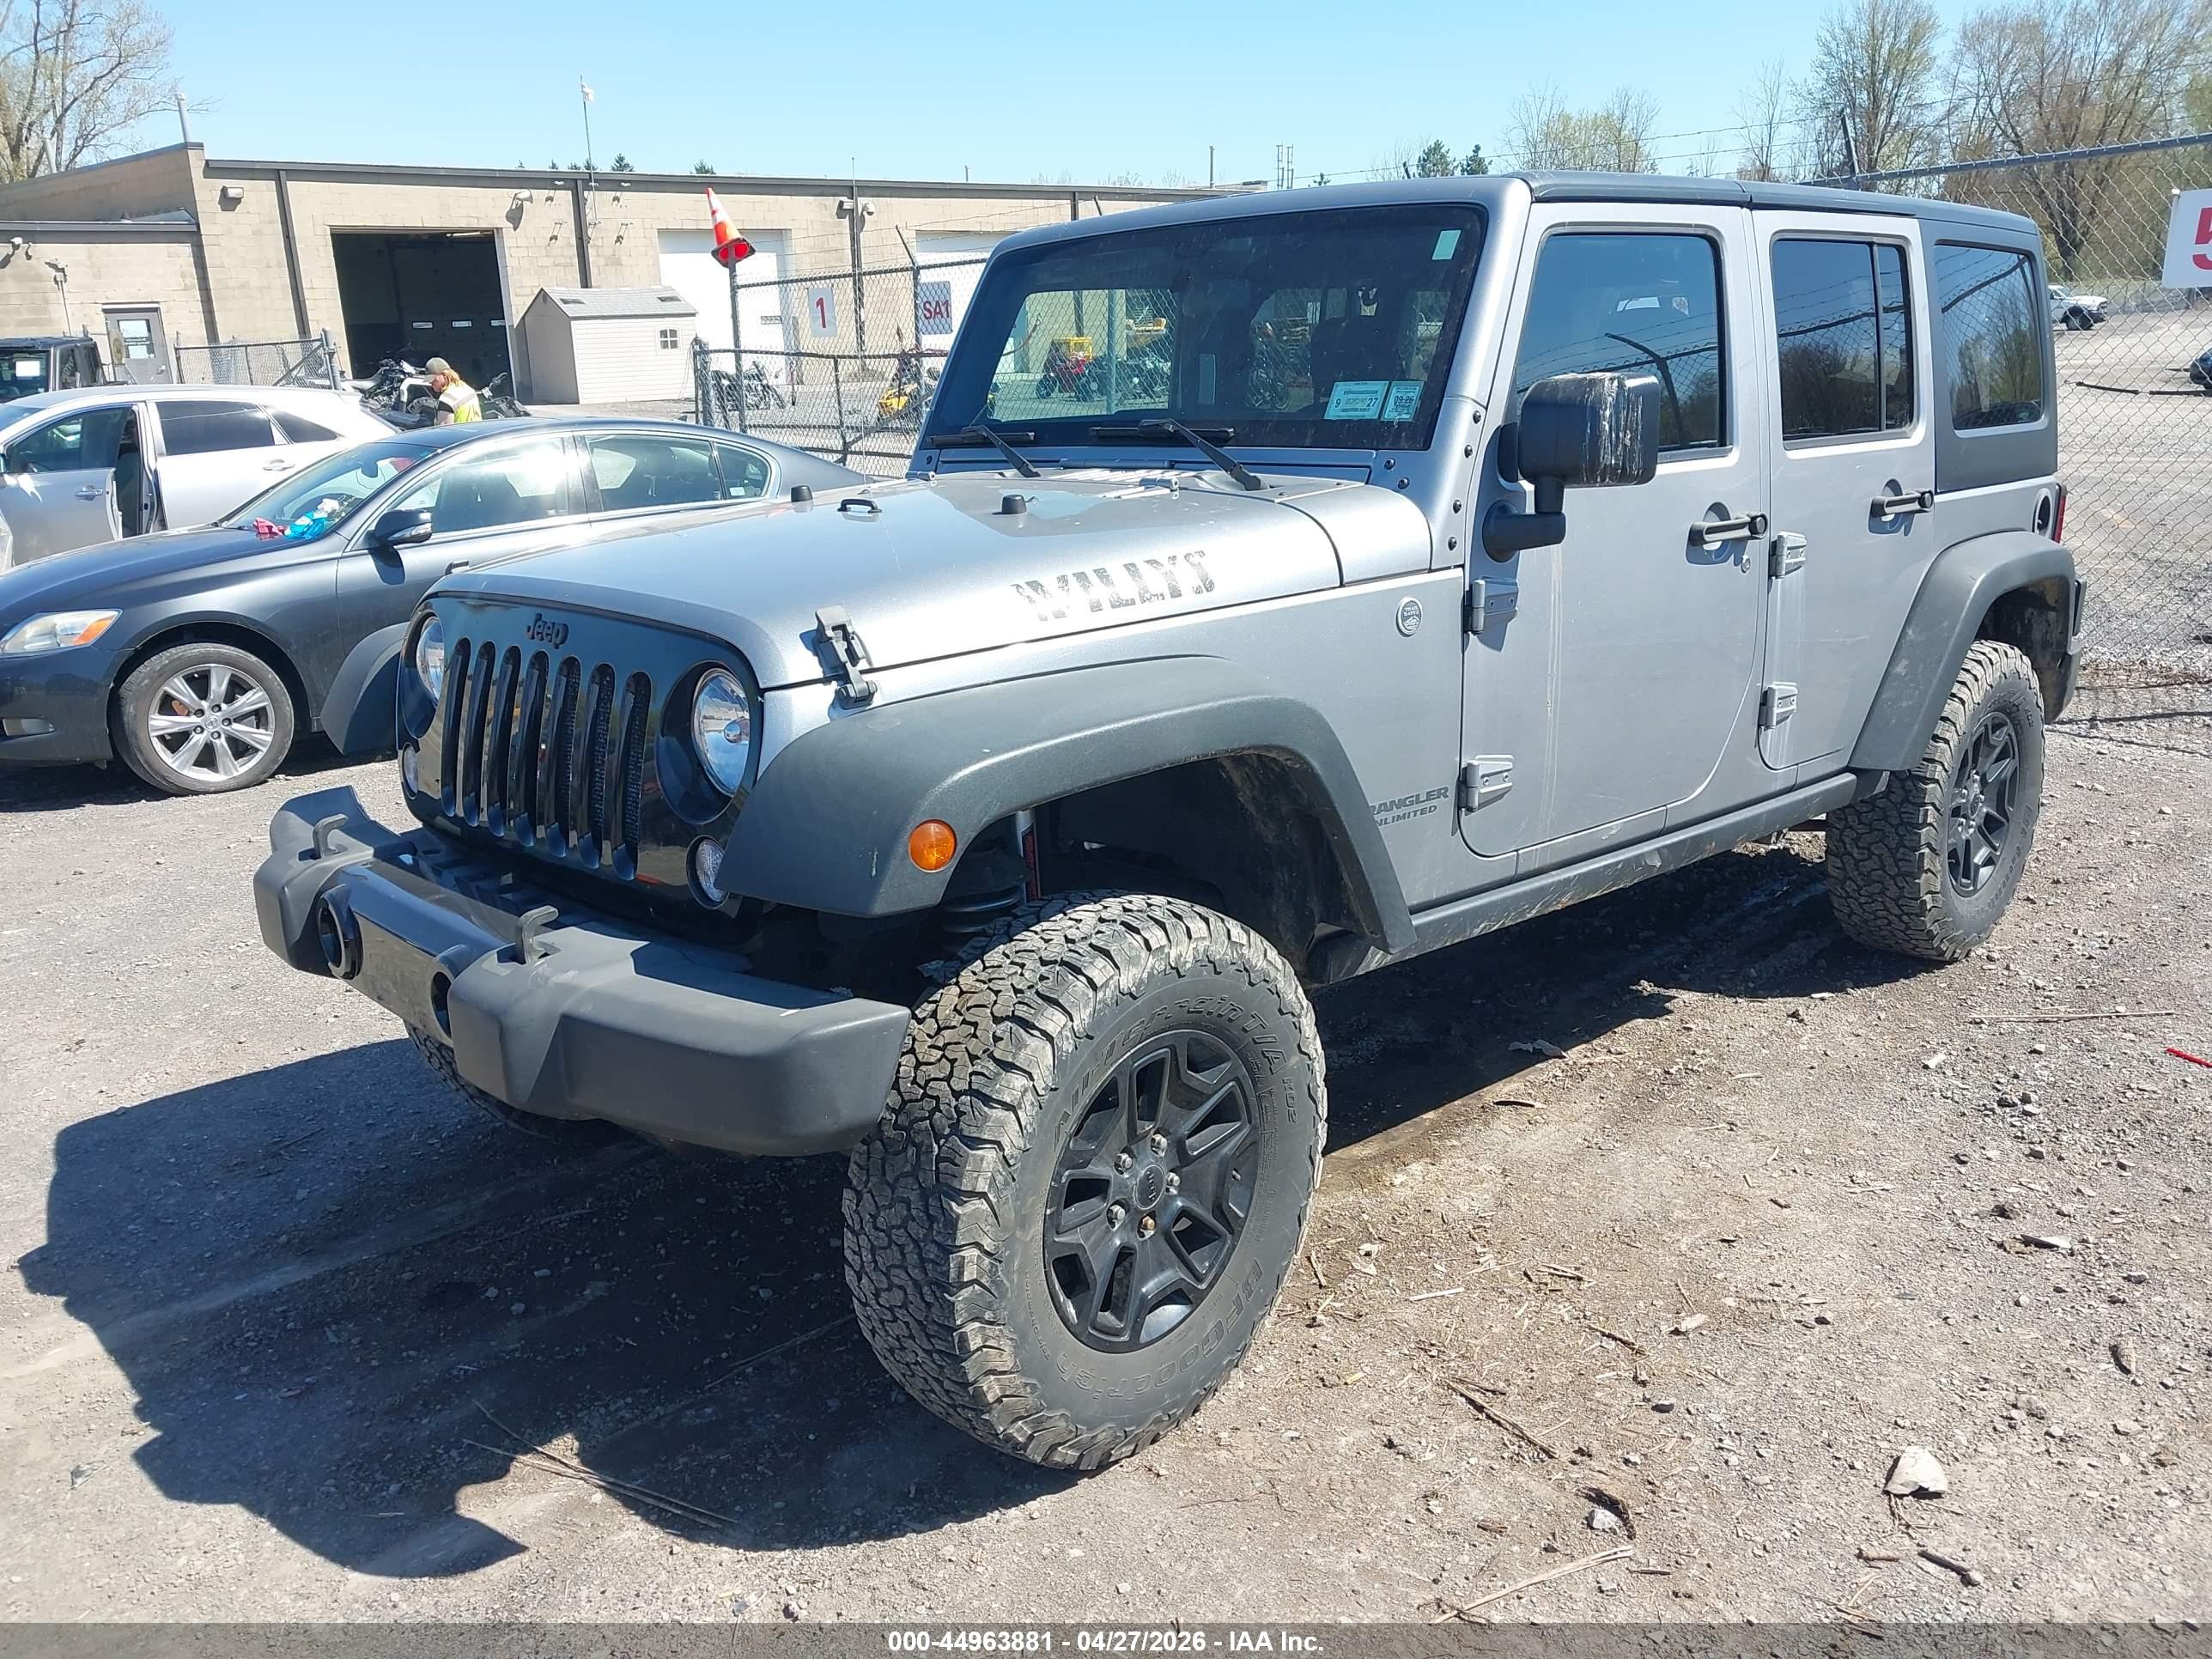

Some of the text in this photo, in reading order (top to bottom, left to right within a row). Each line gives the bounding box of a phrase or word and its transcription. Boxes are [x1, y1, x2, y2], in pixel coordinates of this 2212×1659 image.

[815, 296, 827, 329] 1
[922, 301, 951, 320] SA1
[1334, 398, 1341, 409] 9
[1367, 397, 1379, 408] 27
[1010, 550, 1215, 622] WILLYS
[526, 612, 569, 650] Jeep
[1368, 786, 1449, 816] RANGLER
[1374, 805, 1437, 827] NLIMITED
